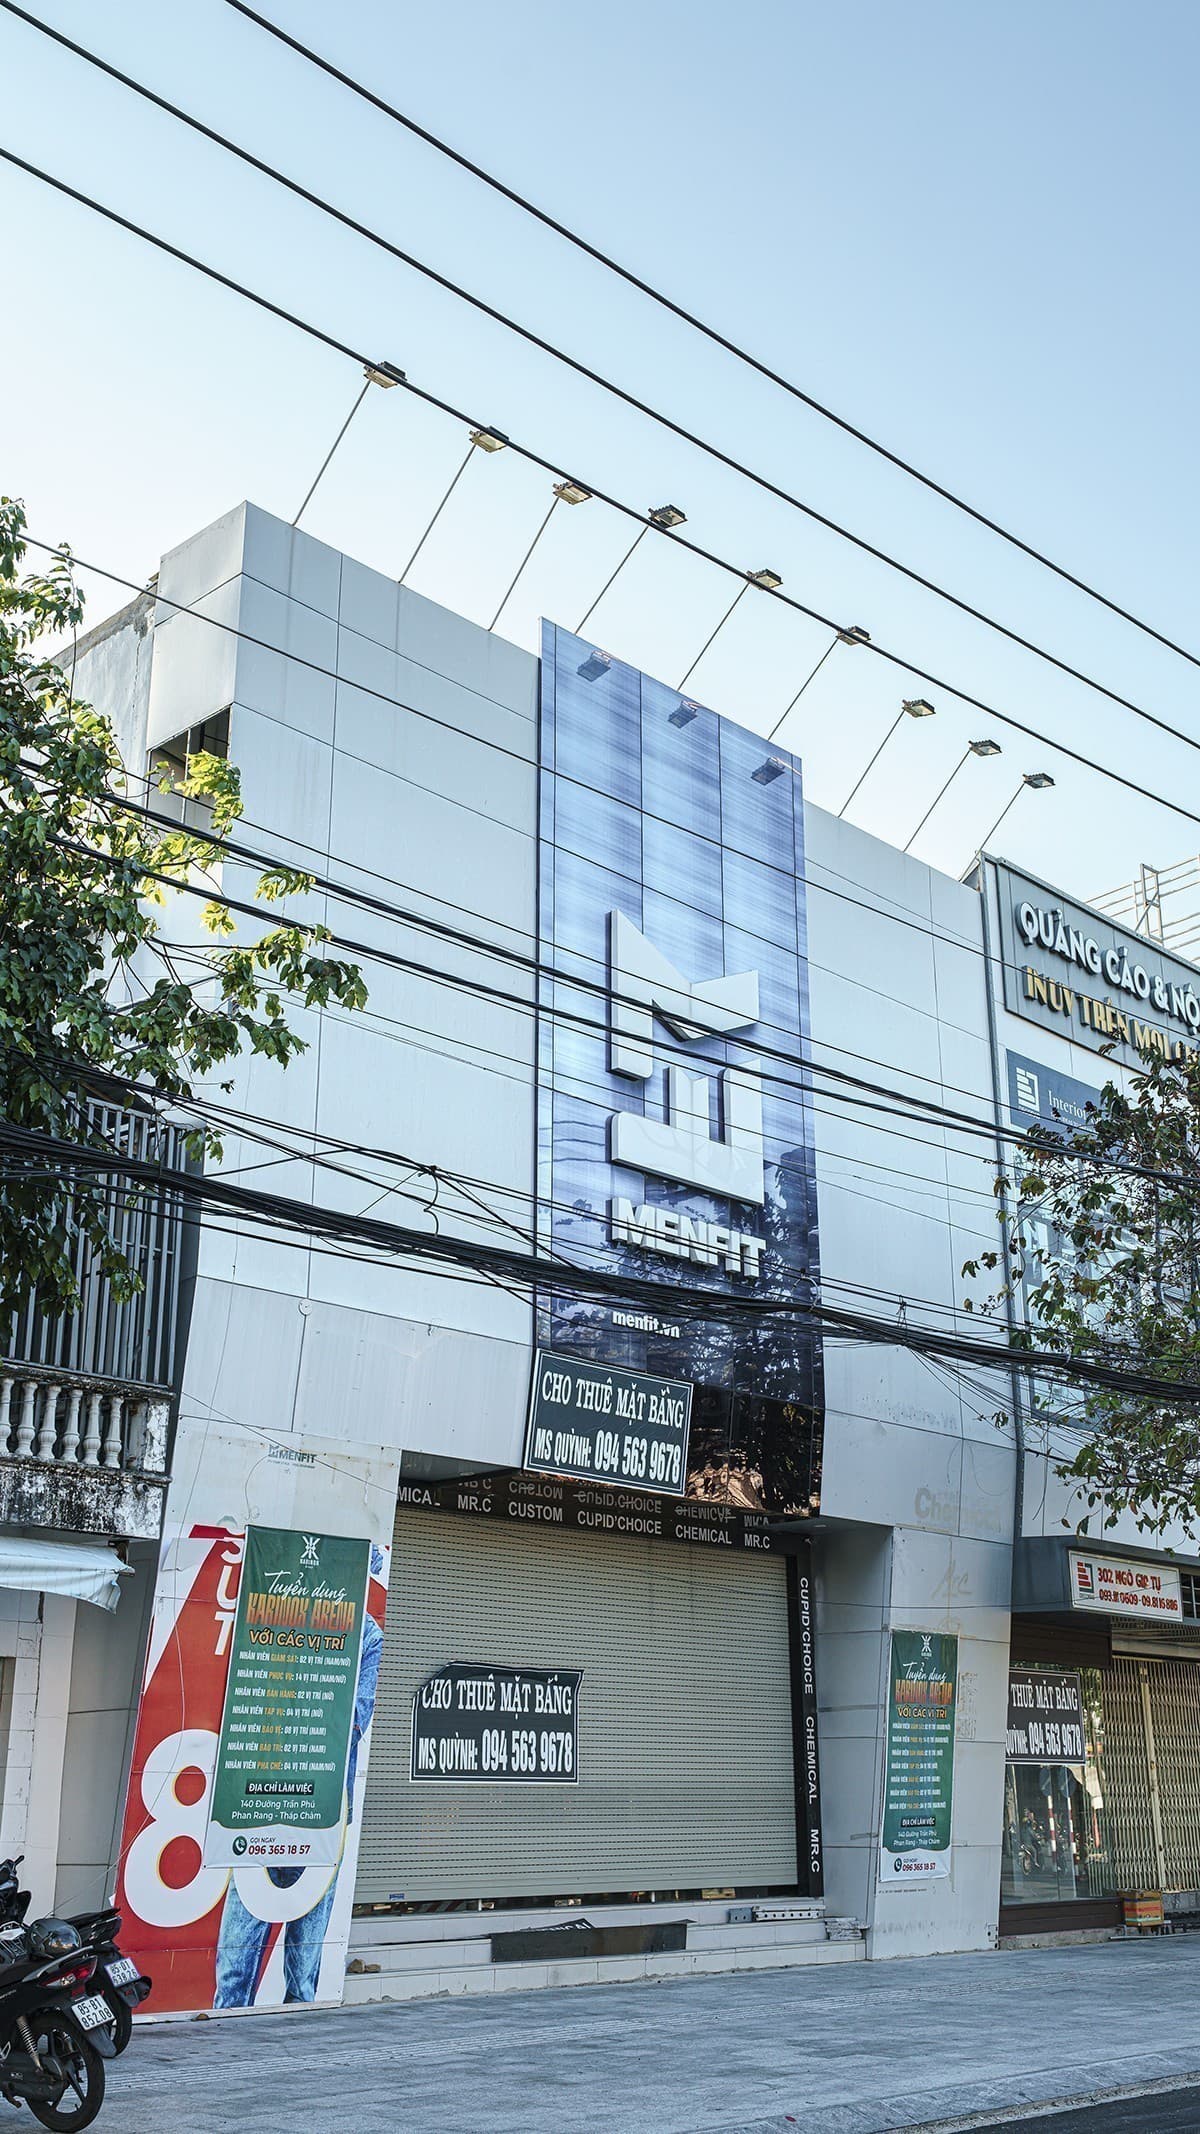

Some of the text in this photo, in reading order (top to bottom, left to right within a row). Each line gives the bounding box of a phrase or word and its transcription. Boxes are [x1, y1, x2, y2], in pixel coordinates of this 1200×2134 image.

[1018, 902, 1200, 1036] QUẢNG CÁO & NỘ
[607, 1197, 767, 1279] MENFIT
[611, 1310, 681, 1339] menfit.vn
[542, 1370, 572, 1406] CHO
[576, 1376, 613, 1415] THUÊ
[615, 1382, 647, 1426] MẶT
[279, 1449, 317, 1463] MENFIT
[534, 1427, 681, 1484] MS QUỲNH: 094 563 9678
[457, 1494, 492, 1513] MR.C
[508, 1501, 563, 1522] CUSTOM
[577, 1510, 662, 1535] CUPID'CHOICE
[675, 1525, 732, 1545] CHEMICAL
[744, 1533, 771, 1550] MR.C
[264, 1570, 309, 1600] Tuyển
[310, 1598, 356, 1632] ARENA
[249, 1627, 347, 1653] VỚI CÁC VỊ TRÍ
[422, 1679, 452, 1709] CHO
[456, 1673, 496, 1711] THUÊ
[500, 1675, 531, 1720] MẶT
[1011, 1678, 1035, 1708] THUÊ
[1035, 1679, 1054, 1715] MẶT
[800, 1576, 820, 1873] CUPID'CHOICE CHEMICAL MR.C
[1028, 1721, 1045, 1755] 094
[1045, 1722, 1061, 1756] 563
[1061, 1723, 1082, 1756] 9678
[418, 1728, 573, 1774] MS QUỲNH: 094 563 9678
[240, 1799, 316, 1809] 140 Đường Trần Phú
[248, 1780, 313, 1795] ĐỊA CHỈ LÀM VIỆC
[231, 1811, 252, 1820] Phan
[253, 1811, 273, 1821] Rang
[280, 1811, 299, 1821] Tháp
[300, 1811, 321, 1820] Chàm
[248, 1845, 311, 1855] 096 365 18 57
